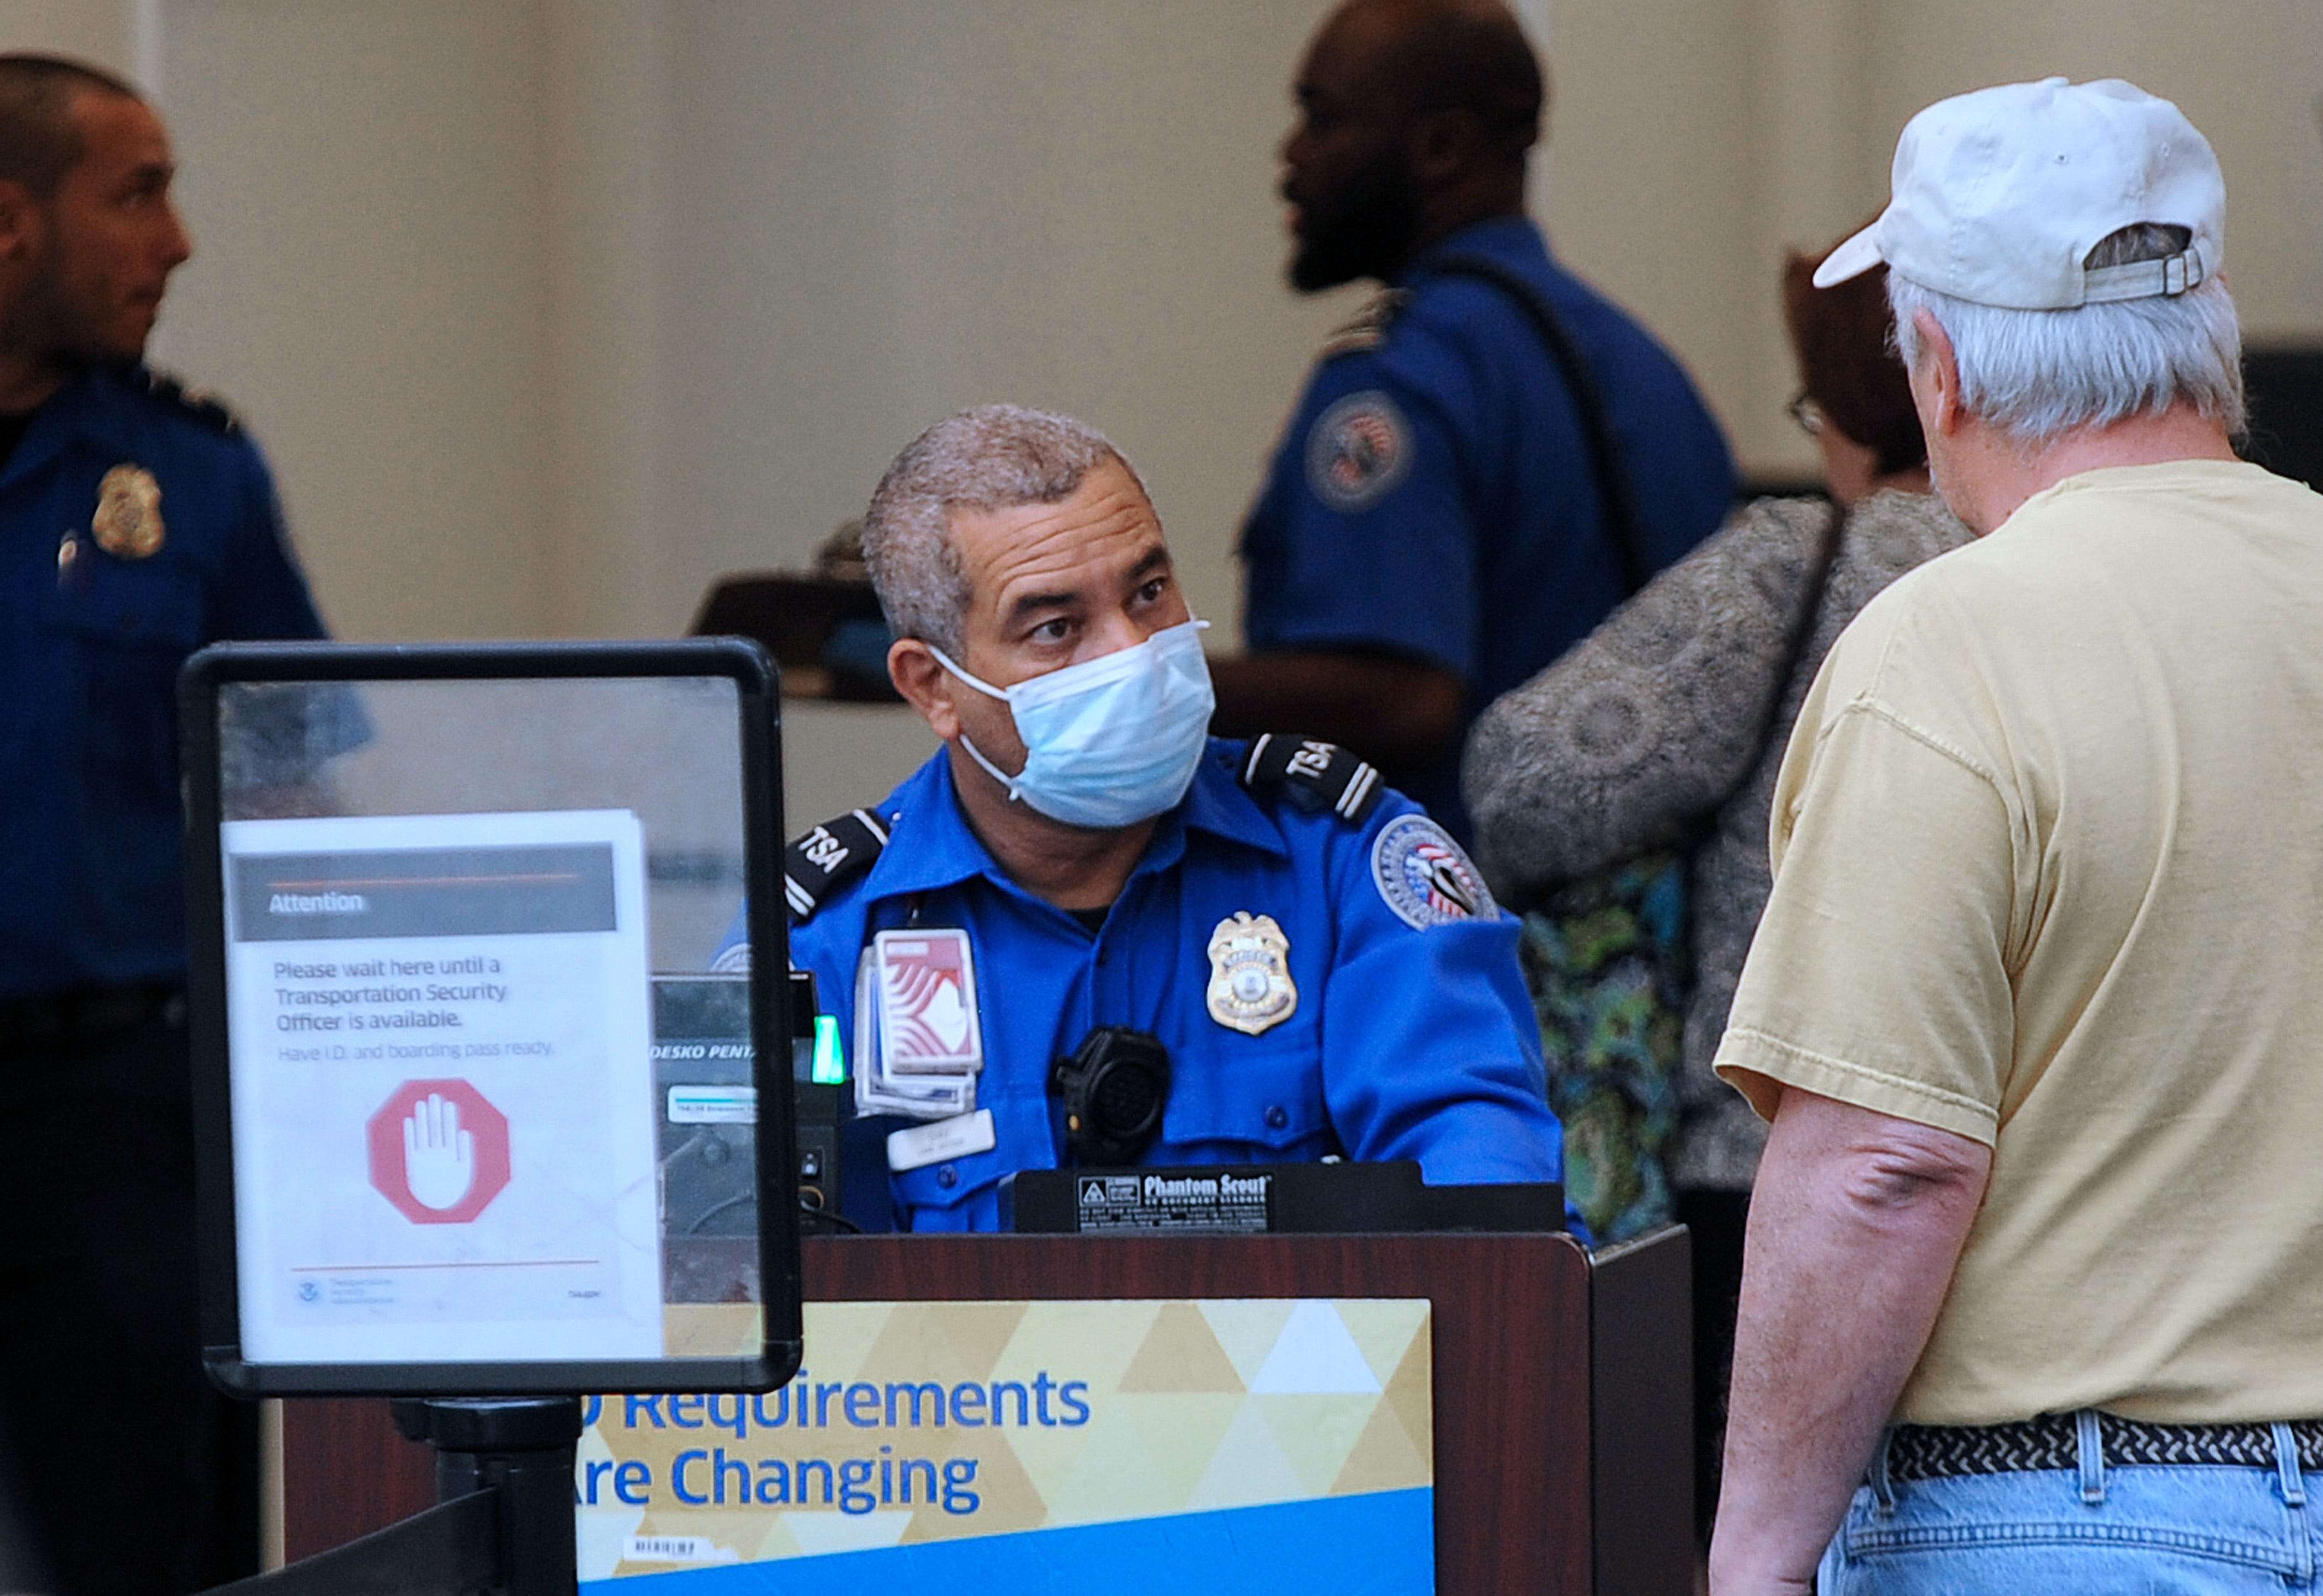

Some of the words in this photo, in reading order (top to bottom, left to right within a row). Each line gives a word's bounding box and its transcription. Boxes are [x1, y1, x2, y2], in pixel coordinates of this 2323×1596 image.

[1286, 740, 1337, 779] TSA
[798, 826, 849, 874] TSA
[269, 890, 364, 913] Attention
[274, 962, 337, 978] Please
[342, 959, 385, 977] wait
[390, 958, 434, 976] here
[440, 955, 483, 974] until
[488, 958, 501, 973] a
[275, 985, 421, 1006] Transportation
[425, 983, 507, 1003] Security
[277, 1013, 342, 1032] Officer
[348, 1011, 364, 1030] is
[368, 1009, 463, 1029] available.
[388, 1042, 461, 1059] boarding
[651, 1045, 706, 1060] DESKO
[709, 1045, 756, 1060] PENT
[1144, 1175, 1217, 1197] Phantom
[1220, 1173, 1266, 1195] Scout
[624, 1370, 1090, 1439] Requirements
[575, 1460, 652, 1505] re
[671, 1445, 981, 1515] Changing
